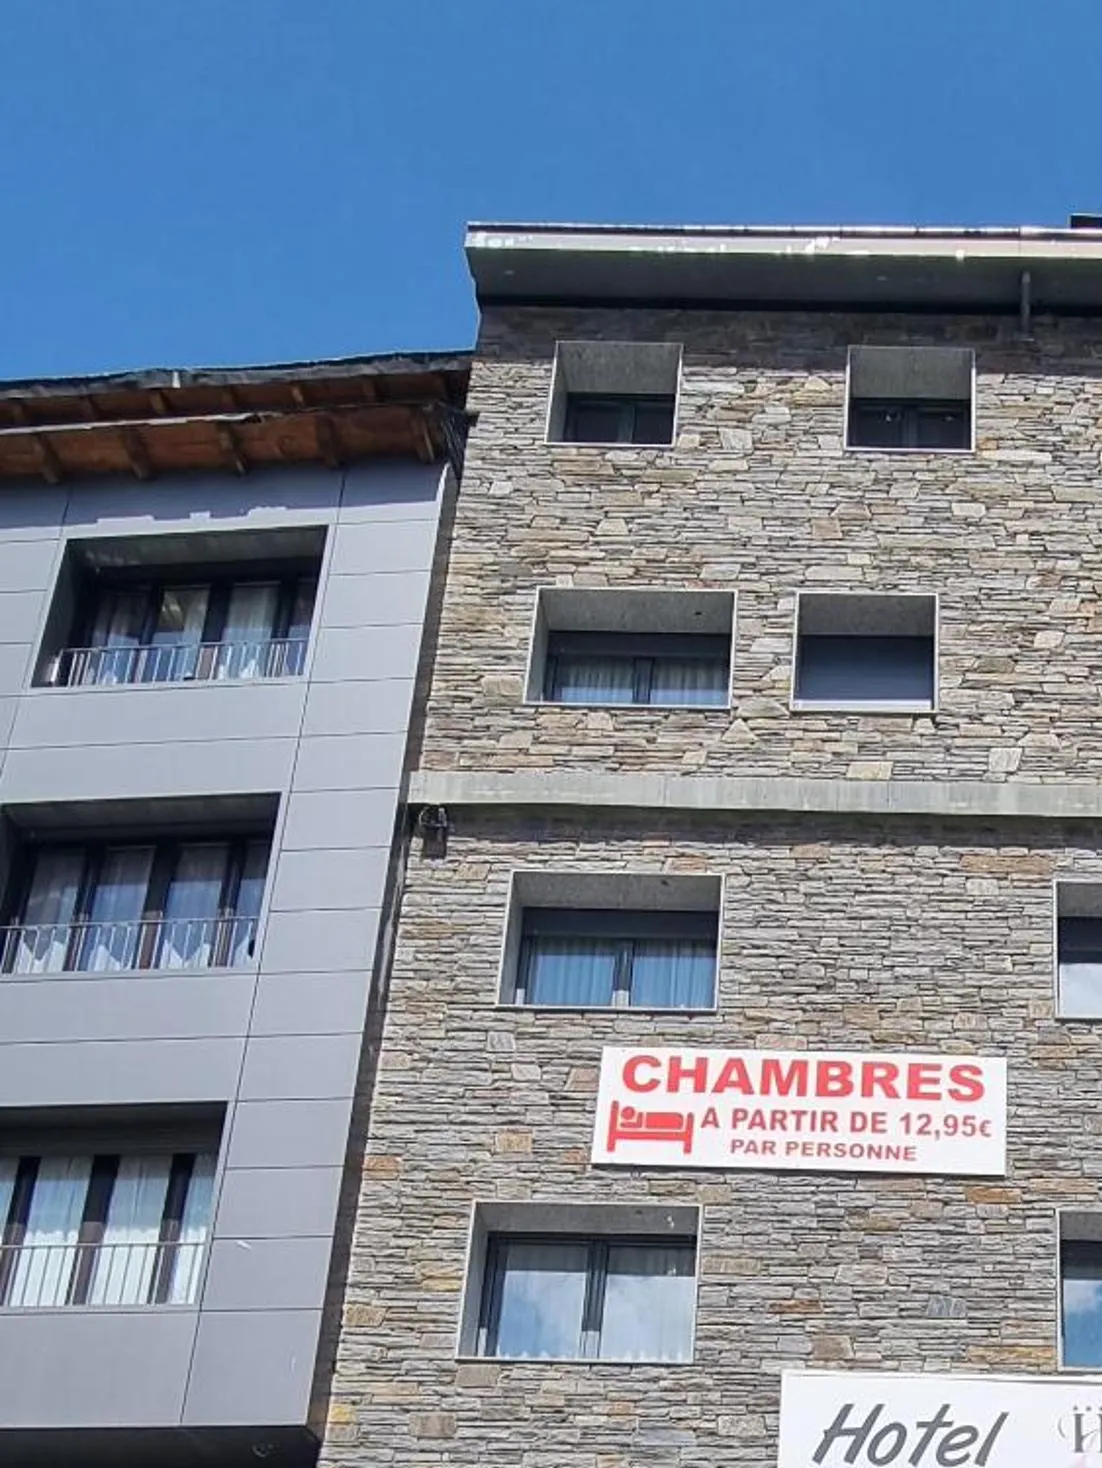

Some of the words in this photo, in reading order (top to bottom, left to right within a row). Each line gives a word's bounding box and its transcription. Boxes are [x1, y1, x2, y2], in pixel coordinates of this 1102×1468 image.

[622, 1055, 985, 1102] CHAMBRES
[700, 1107, 720, 1129] A
[731, 1108, 844, 1133] PARTIR
[849, 1111, 887, 1135] DE
[899, 1113, 992, 1140] 12,95€
[730, 1139, 776, 1155] PAR
[785, 1141, 917, 1161] PERSONNE
[811, 1403, 1009, 1468] Hotel
